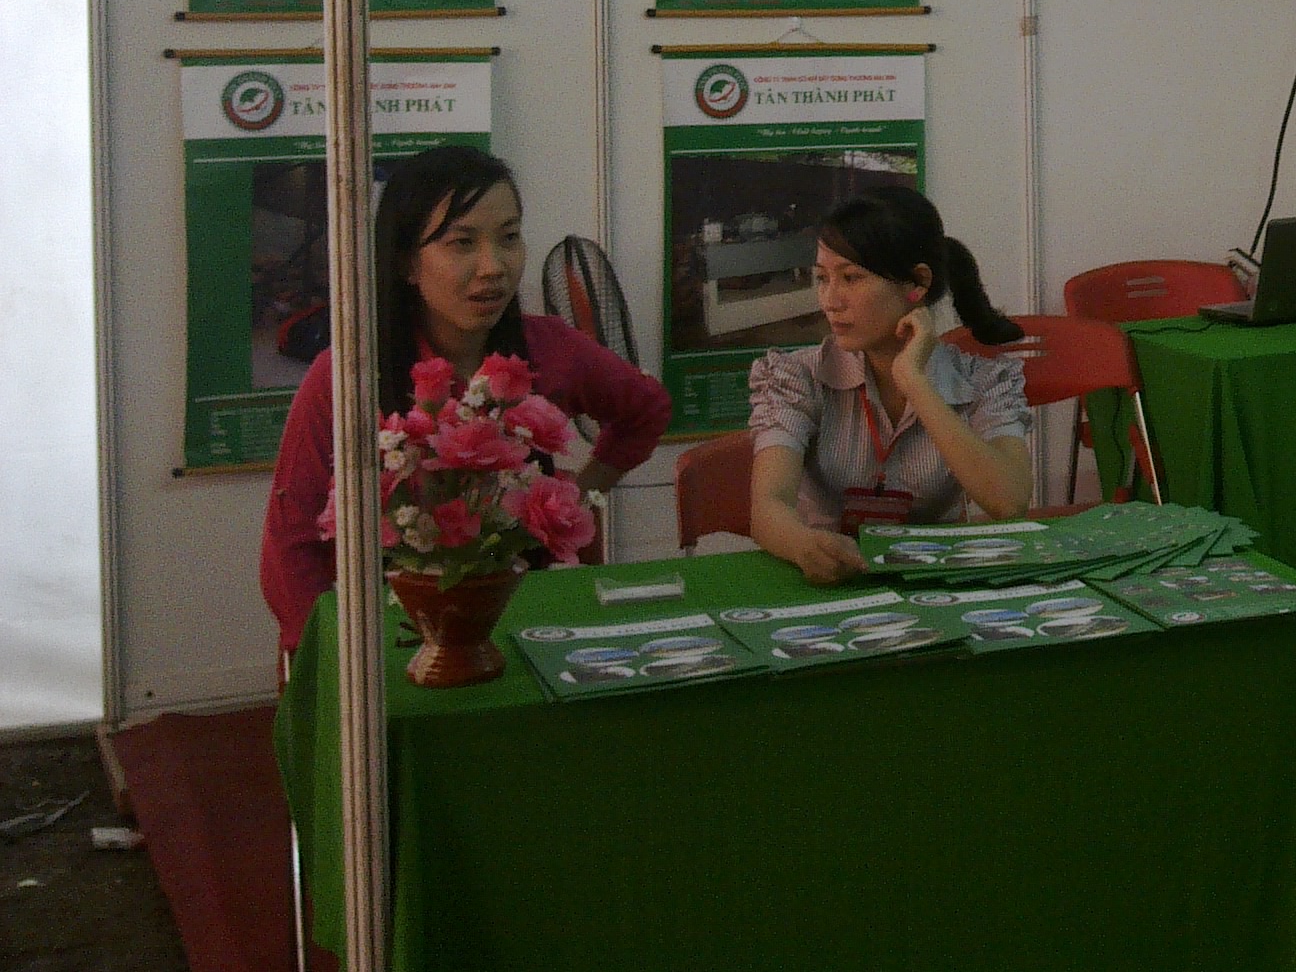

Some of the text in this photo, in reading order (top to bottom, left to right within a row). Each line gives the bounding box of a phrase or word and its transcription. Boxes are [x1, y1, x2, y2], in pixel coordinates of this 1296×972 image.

[754, 86, 897, 105] TÂN THÀNH PHÁT
[405, 97, 457, 114] PHÁT
